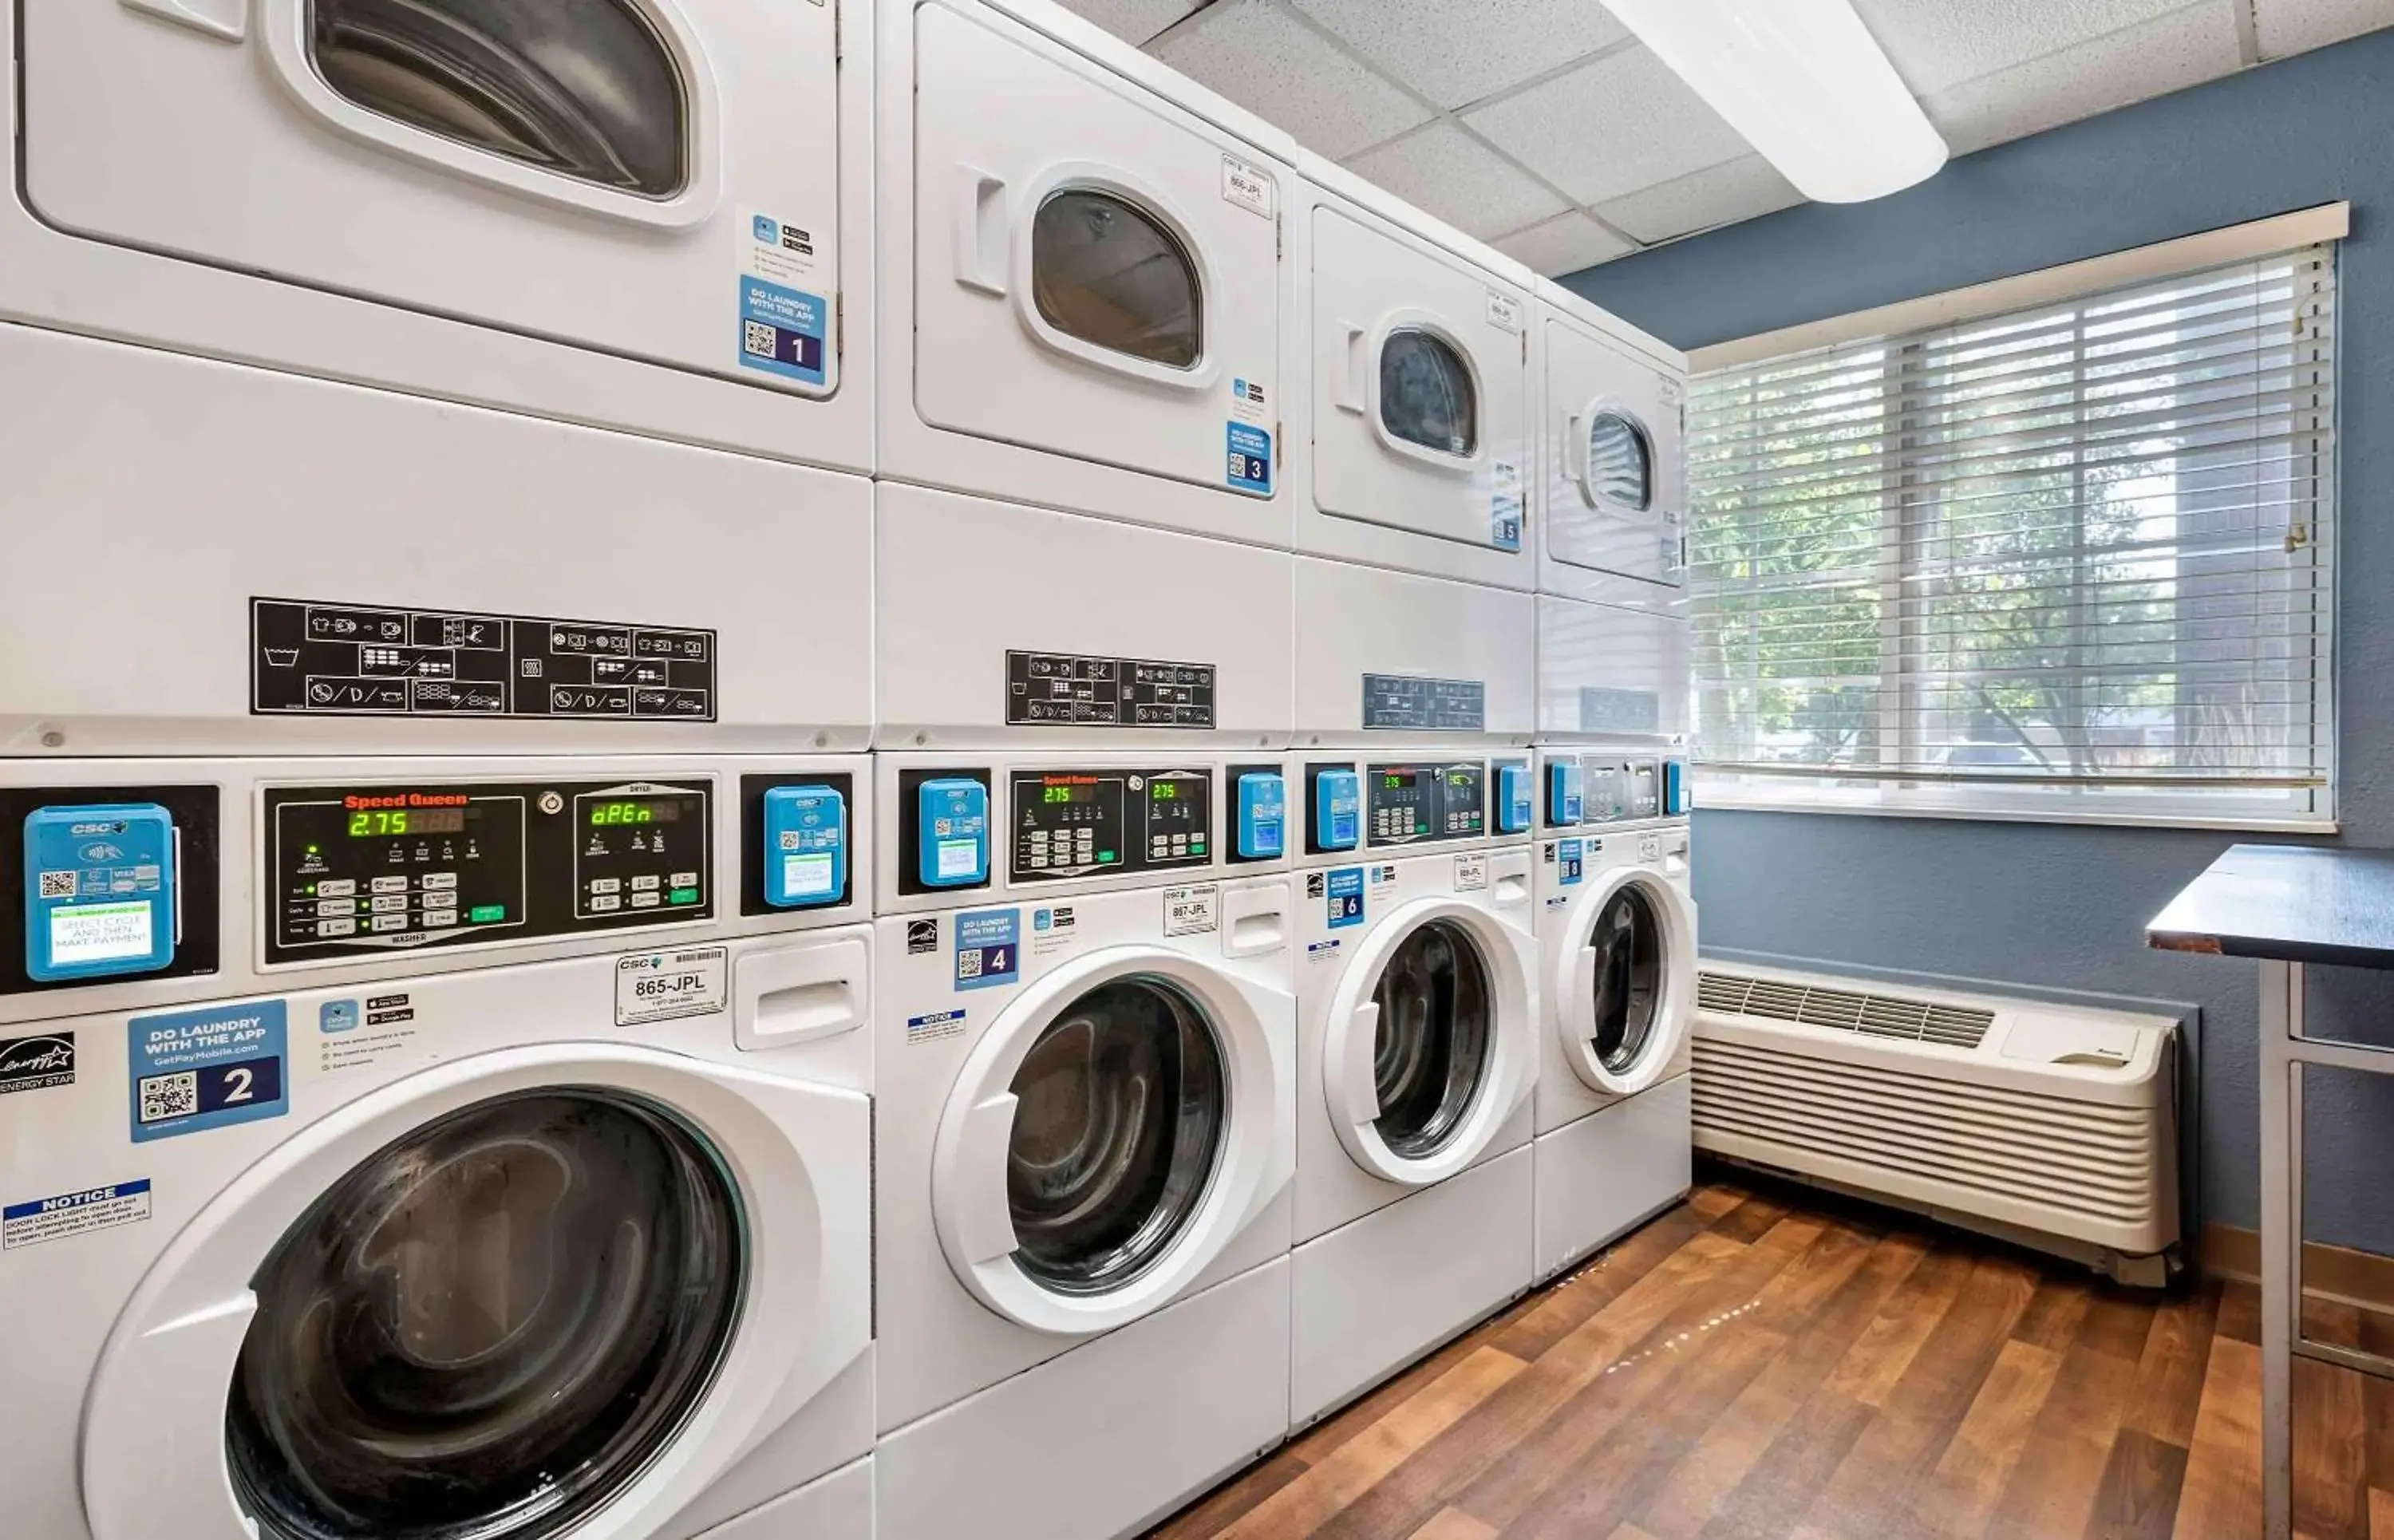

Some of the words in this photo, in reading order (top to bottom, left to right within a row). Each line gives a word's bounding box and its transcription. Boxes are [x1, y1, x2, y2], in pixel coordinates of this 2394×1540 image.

[748, 296, 775, 310] WITH
[796, 310, 814, 322] APP
[768, 293, 812, 312] LAUNDRY
[792, 338, 803, 362] 1
[1252, 460, 1261, 478] 3
[344, 794, 406, 810] Speed
[409, 792, 468, 805] Queen
[70, 823, 111, 835] CSC
[350, 812, 407, 835] 2.75
[1571, 861, 1578, 875] 8
[1348, 898, 1357, 914] 6
[73, 928, 101, 938] AND
[105, 926, 132, 935] THEN
[391, 934, 428, 944] WASHER
[55, 938, 89, 948] MAKE
[620, 958, 649, 970] CSC
[991, 949, 1006, 970] 4
[635, 974, 706, 997] 865-JPL
[150, 1029, 176, 1043] DO
[181, 1017, 262, 1038] LAUNDRY
[145, 1040, 192, 1055] WITH
[196, 1033, 230, 1048] THE
[234, 1028, 267, 1042] APP
[153, 1044, 259, 1067] GetPayMobile.com
[1, 1078, 45, 1092] ENERGY
[45, 1073, 75, 1086] STAR
[224, 1068, 254, 1104] 2
[42, 1187, 116, 1211] NOTICE
[6, 1218, 34, 1229] DOOR
[34, 1213, 60, 1223] LOCK
[61, 1207, 88, 1218] LIGHT
[6, 1226, 35, 1236] before
[35, 1217, 80, 1230] attempting
[91, 1210, 112, 1220] open
